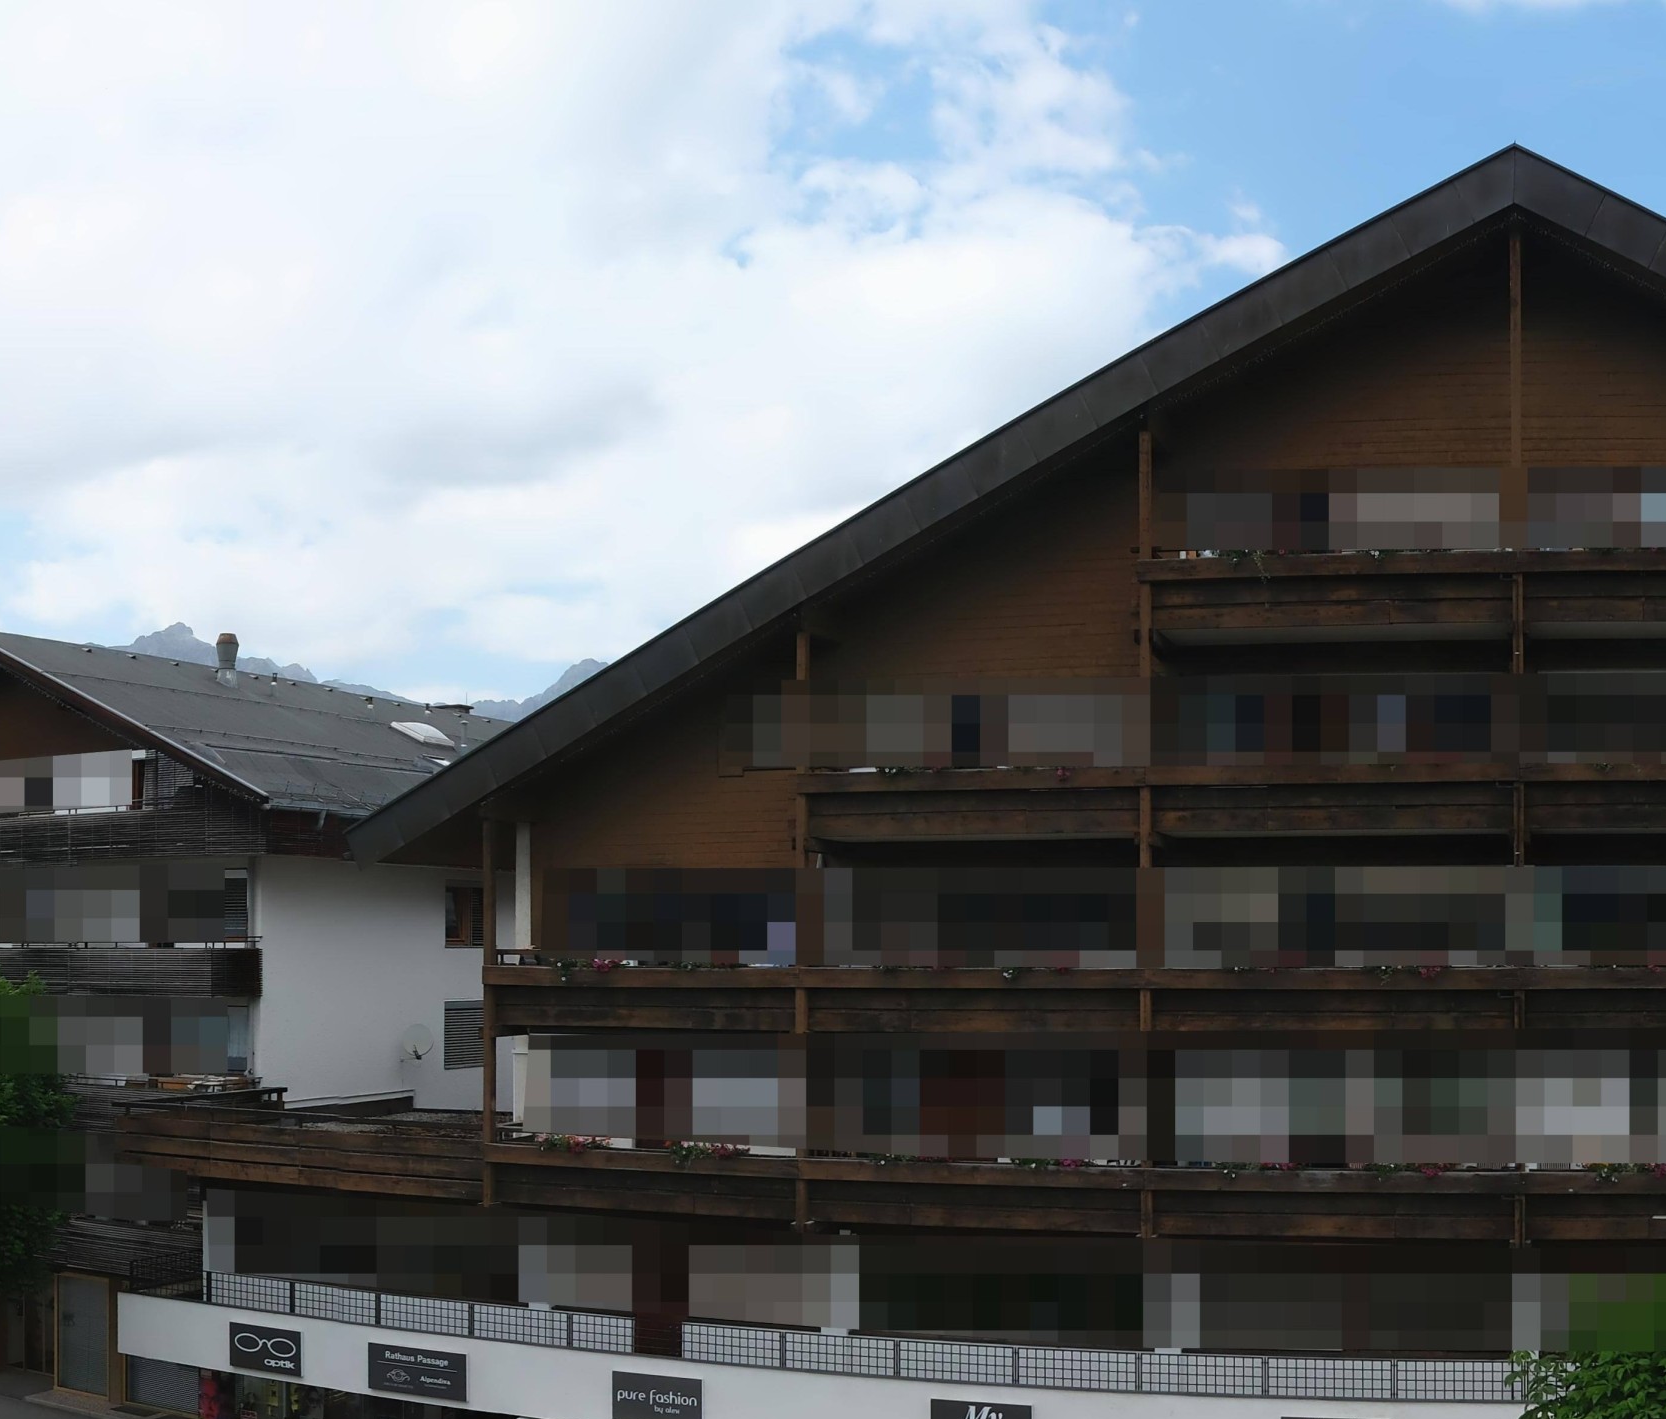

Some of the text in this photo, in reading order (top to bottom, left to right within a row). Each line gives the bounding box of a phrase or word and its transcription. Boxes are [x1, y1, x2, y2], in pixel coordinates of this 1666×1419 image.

[264, 1358, 296, 1369] optik
[385, 1350, 449, 1367] Rathaus Passage
[617, 1390, 646, 1402] pure
